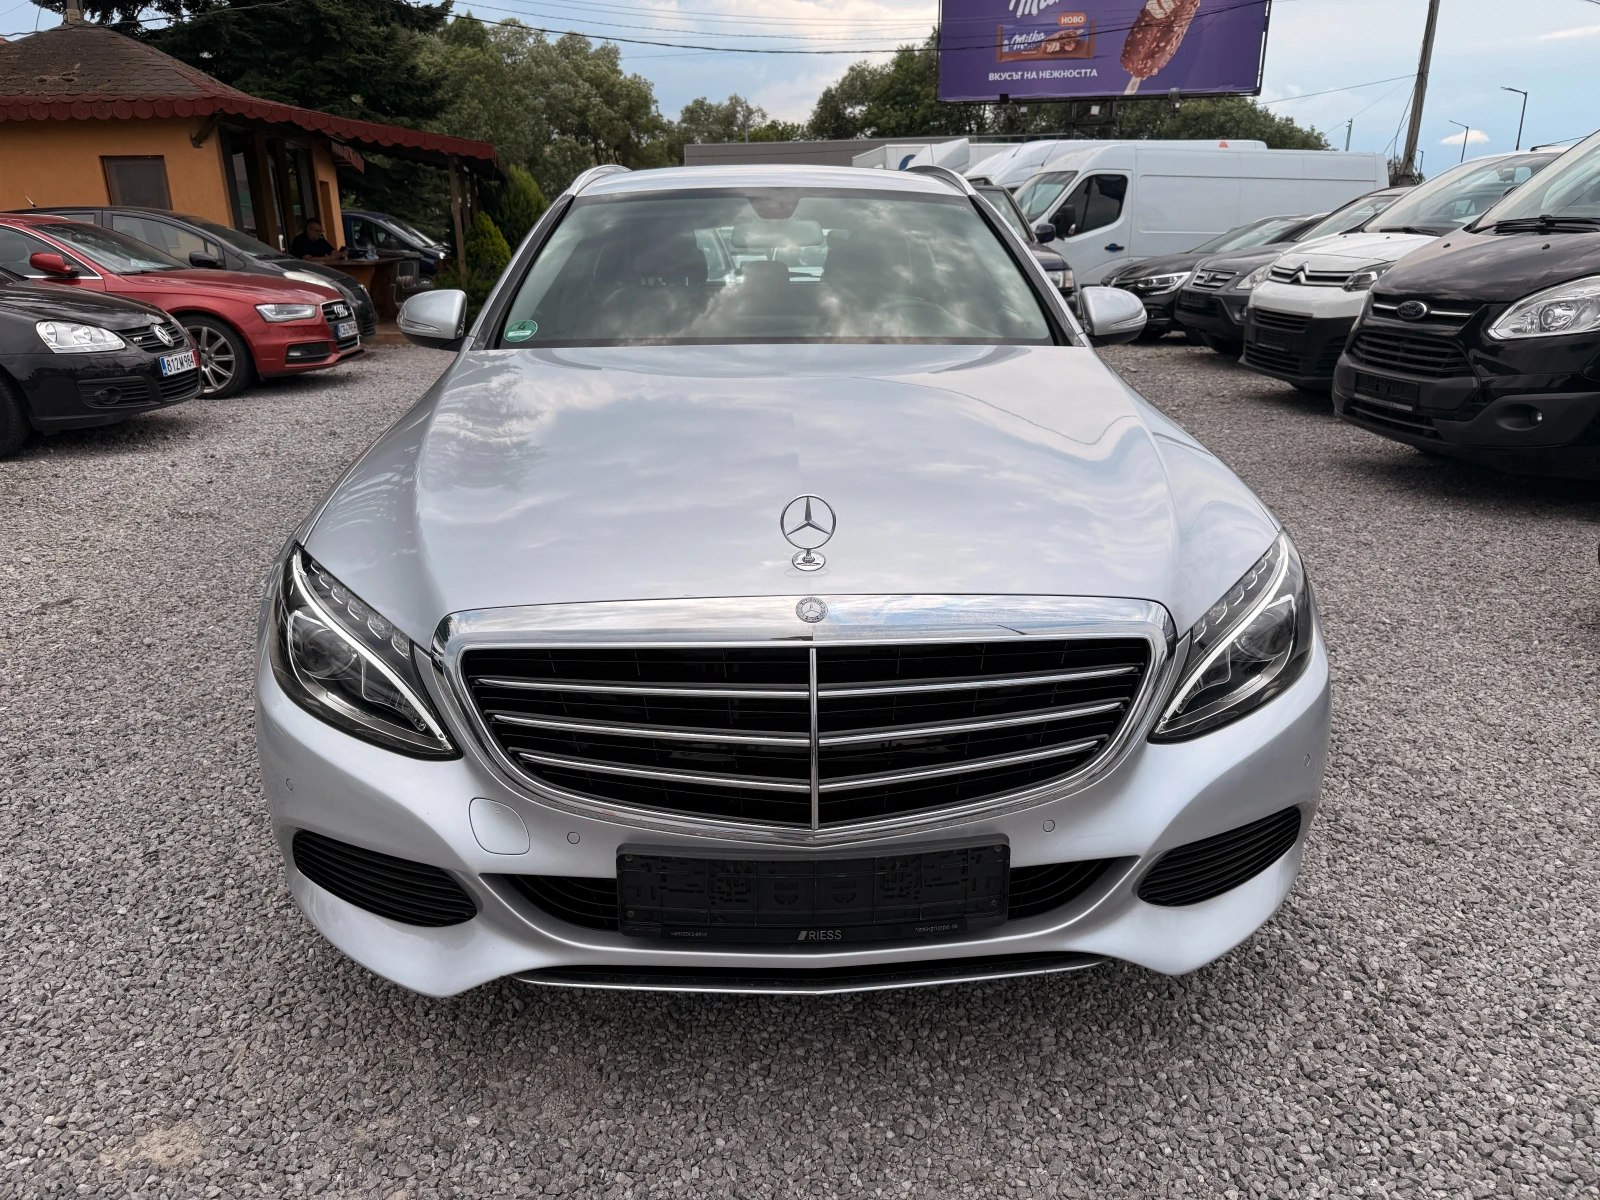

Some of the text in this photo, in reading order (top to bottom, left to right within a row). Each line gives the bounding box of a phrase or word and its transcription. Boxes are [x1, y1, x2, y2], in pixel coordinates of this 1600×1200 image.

[1061, 16, 1084, 24] НОВО
[1010, 30, 1046, 50] Milka
[988, 69, 1098, 81] ВКУСЪТ НА НЕЖНОСТТА
[808, 930, 842, 941] RIESS
